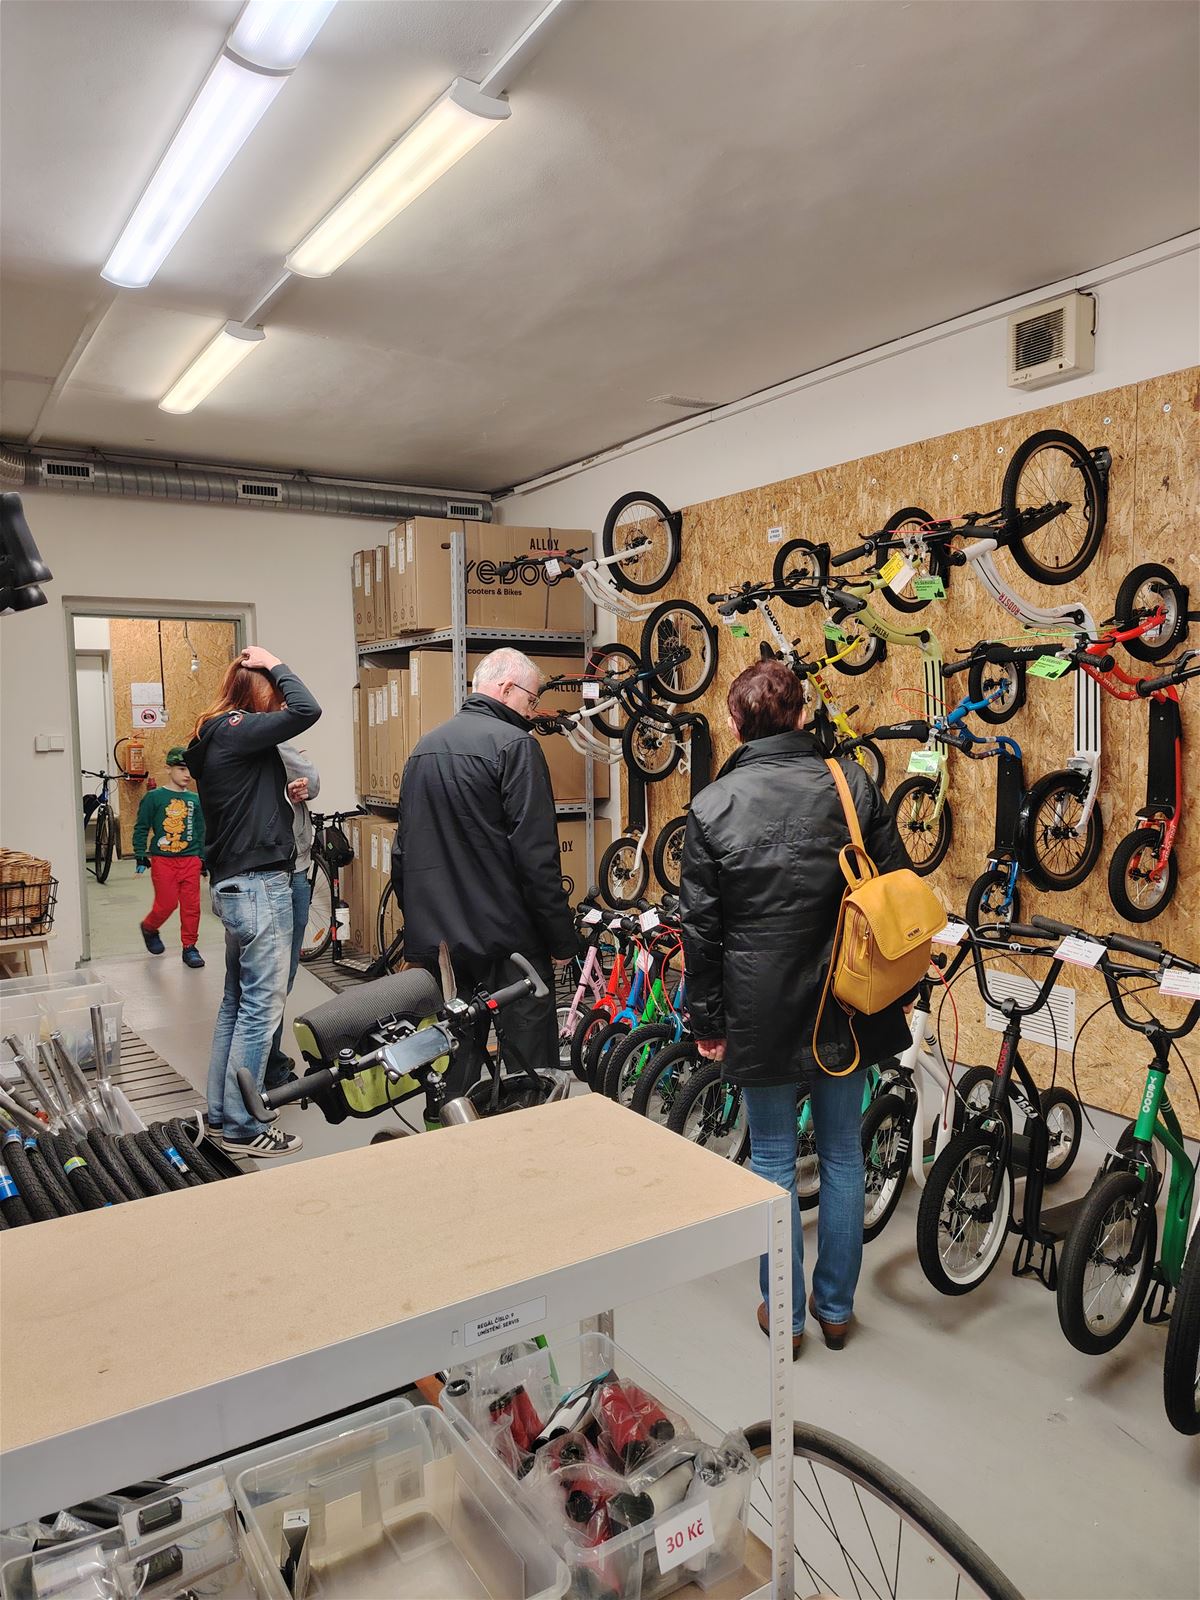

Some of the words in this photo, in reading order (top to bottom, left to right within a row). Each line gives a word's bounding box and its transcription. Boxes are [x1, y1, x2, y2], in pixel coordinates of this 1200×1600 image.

[530, 538, 560, 550] ALLOY
[466, 588, 496, 596] cooters
[998, 592, 1021, 616] RODSTR
[502, 1317, 520, 1328] SERVIS
[665, 1531, 684, 1554] 30
[687, 1517, 705, 1541] Kč
